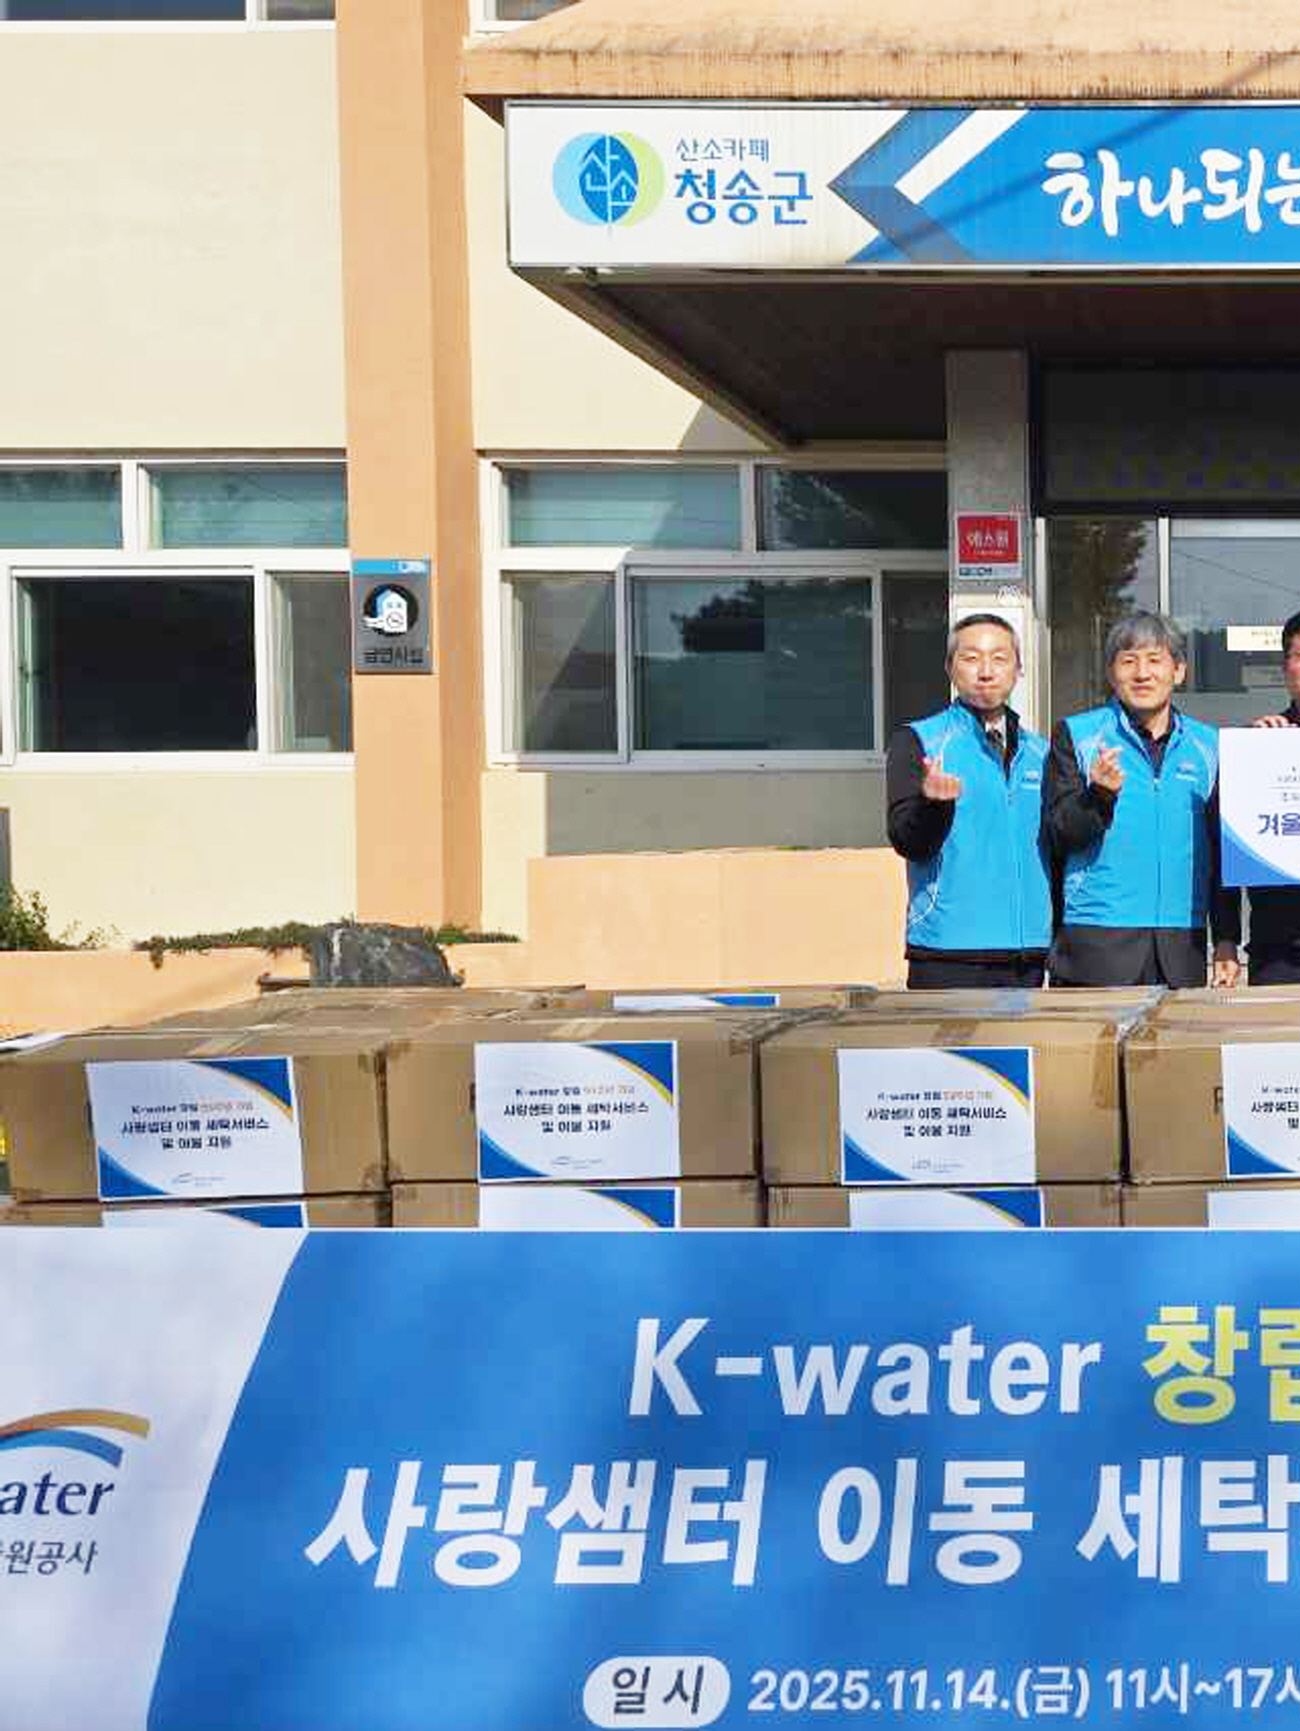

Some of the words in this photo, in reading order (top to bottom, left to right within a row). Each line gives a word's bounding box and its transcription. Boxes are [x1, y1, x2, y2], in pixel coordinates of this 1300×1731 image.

[677, 138, 770, 163] 산소카페
[674, 168, 814, 226] 청송군
[630, 1317, 1103, 1416] K-water
[304, 1460, 767, 1588] 사랑샘터
[818, 1458, 1034, 1586] 이동
[0, 1540, 99, 1576] 원공사
[747, 1666, 1090, 1719] 2025.11.14.(금)
